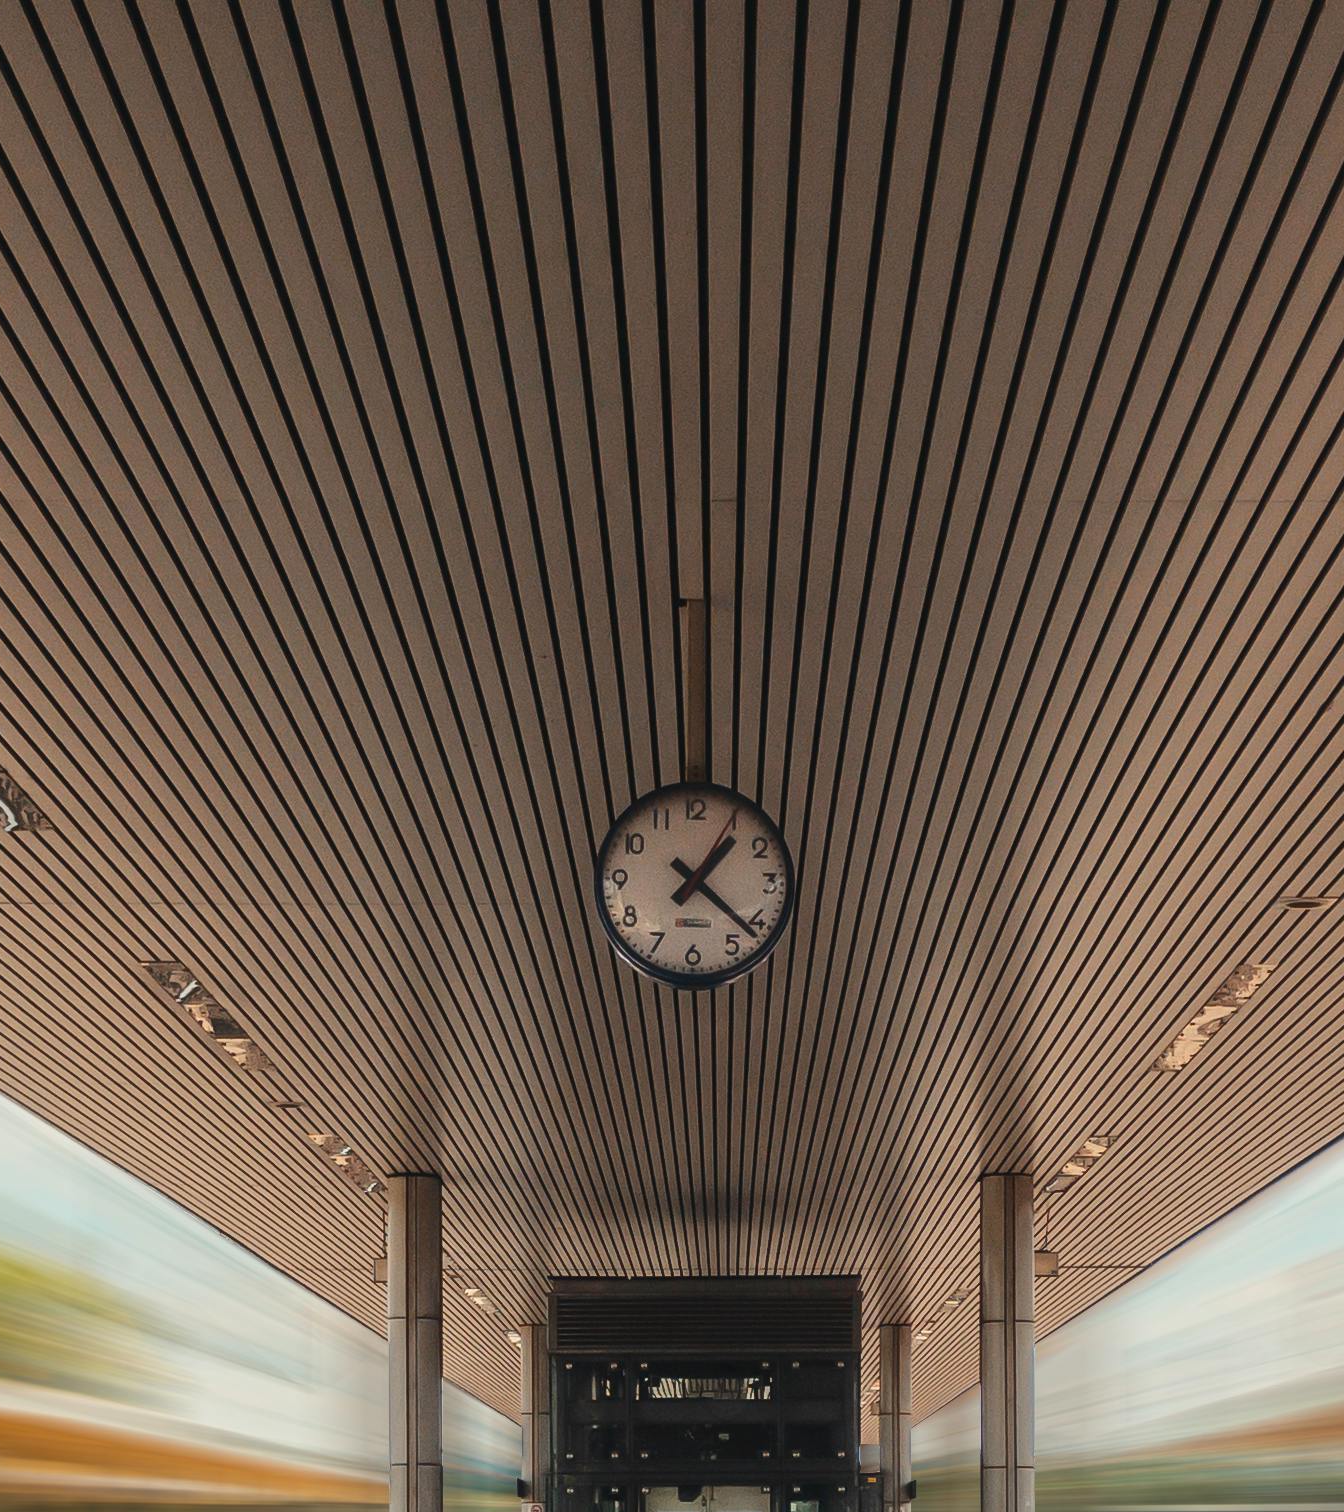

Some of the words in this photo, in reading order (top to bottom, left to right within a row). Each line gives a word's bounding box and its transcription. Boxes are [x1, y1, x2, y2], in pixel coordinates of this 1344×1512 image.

[653, 808, 670, 830] 11
[686, 800, 707, 820] 12
[625, 833, 645, 854] 10
[752, 837, 768, 858] 2
[612, 869, 628, 890] 9
[763, 873, 777, 894] 3
[622, 905, 638, 927] 8
[748, 909, 766, 930] 4
[649, 932, 665, 953] 7
[726, 934, 740, 955] 5
[685, 944, 702, 966] 6
